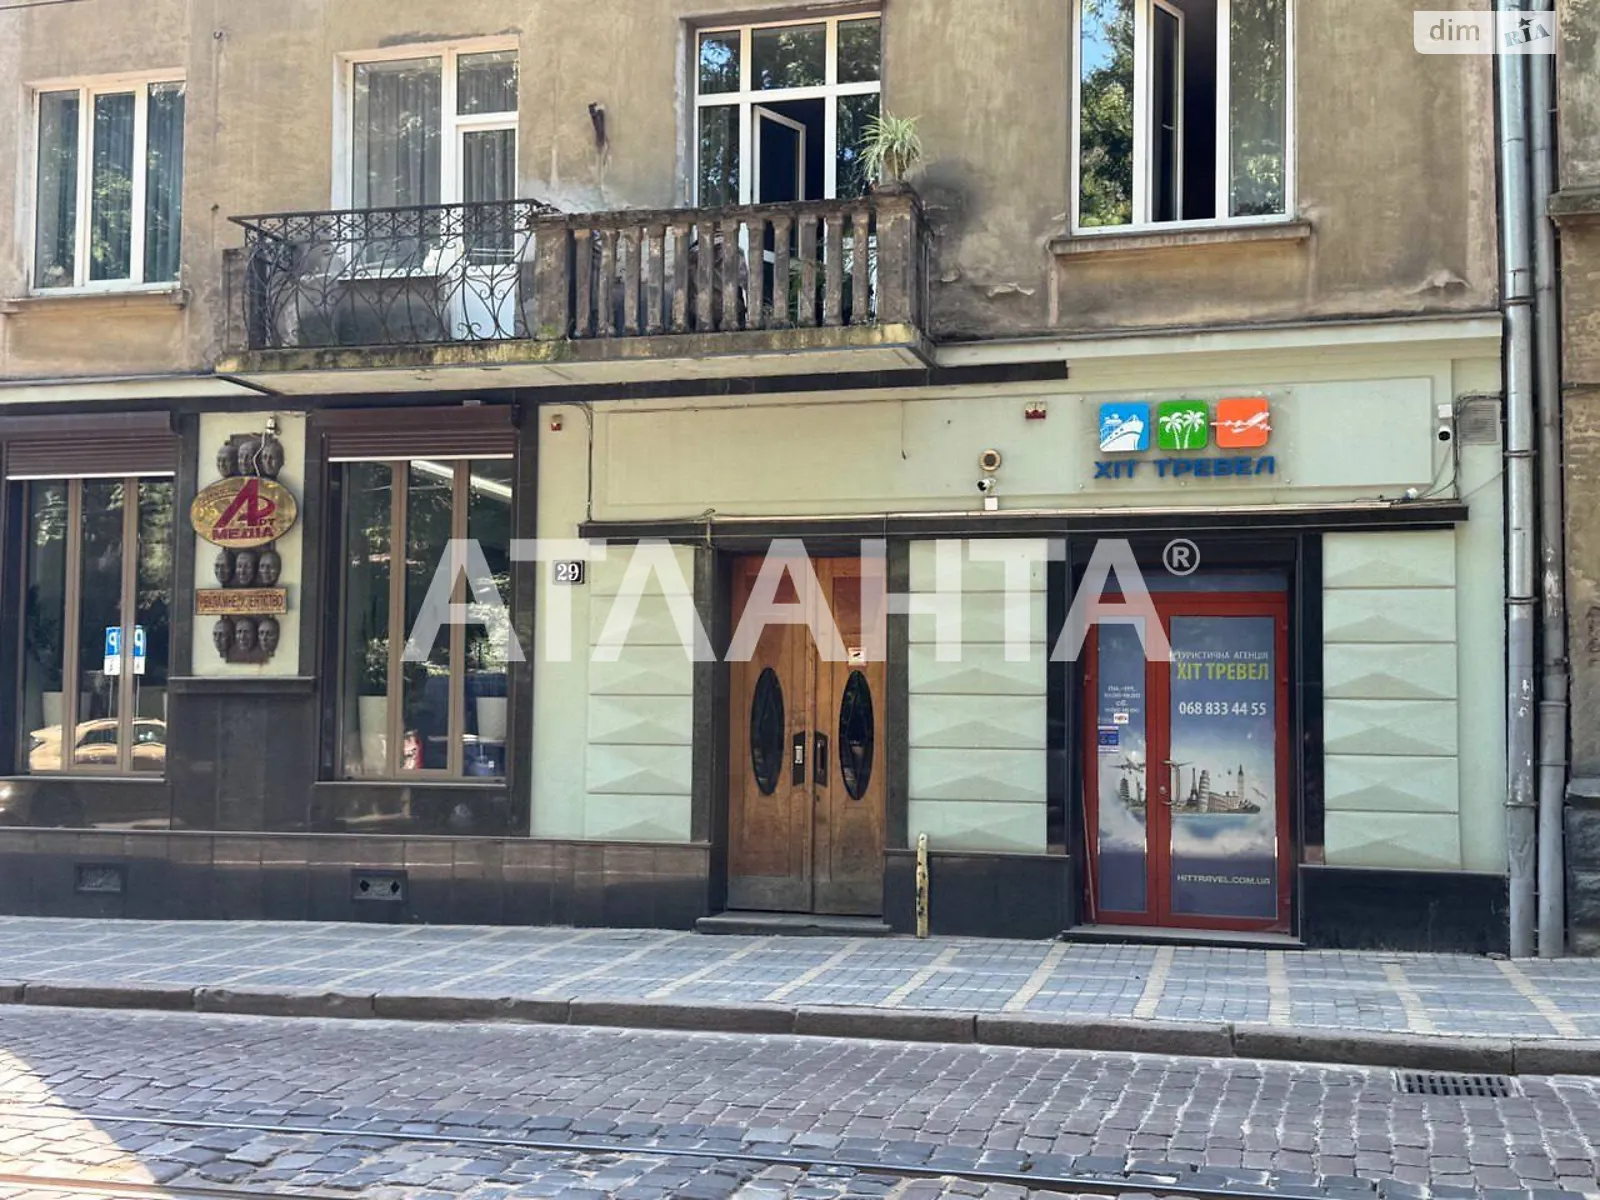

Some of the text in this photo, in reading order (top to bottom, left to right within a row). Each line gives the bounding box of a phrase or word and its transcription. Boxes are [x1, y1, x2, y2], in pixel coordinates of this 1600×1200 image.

[1094, 455, 1276, 480] ХІТ ТРЕВЕЛ
[557, 563, 580, 581] 29
[1177, 662, 1269, 681] ХІТ ТРЕВЕЛ
[1179, 701, 1267, 716] 068 833 44 55
